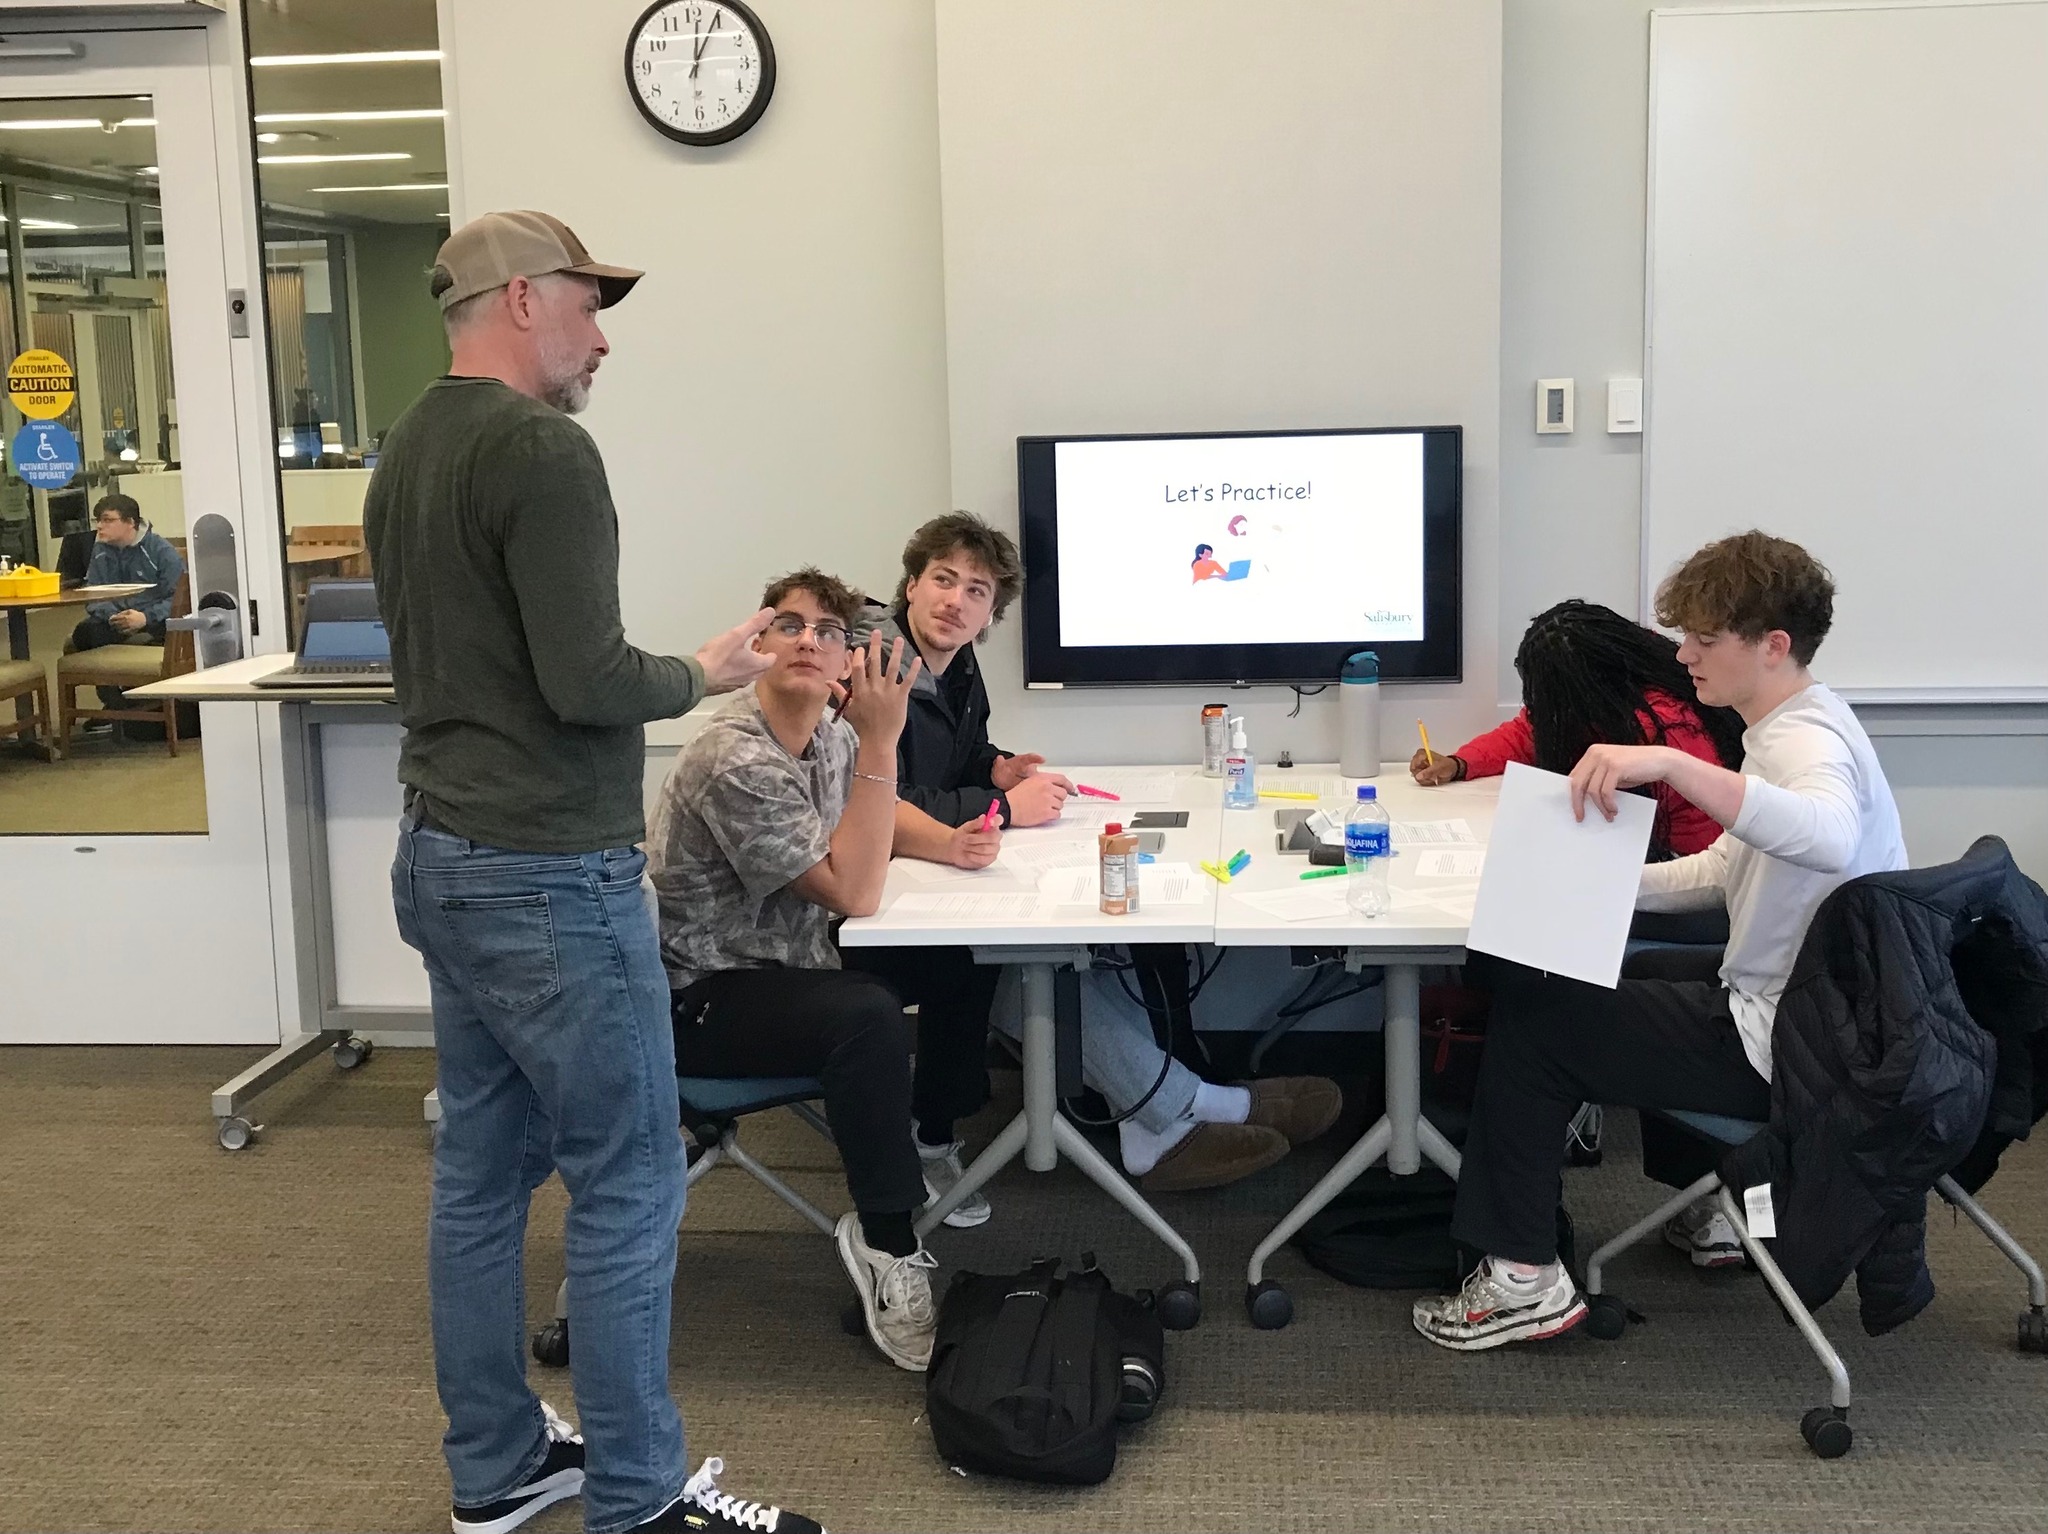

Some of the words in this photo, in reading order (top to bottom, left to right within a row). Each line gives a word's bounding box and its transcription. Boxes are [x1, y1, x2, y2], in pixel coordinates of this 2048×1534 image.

[685, 7, 702, 23] 12
[662, 16, 678, 32] 11
[650, 36, 666, 52] 10
[733, 34, 742, 48] 2
[642, 60, 652, 76] 9
[739, 55, 750, 71] 3
[651, 83, 662, 97] 8
[735, 78, 743, 94] 4
[672, 100, 681, 116] 7
[717, 98, 727, 113] 5
[695, 106, 705, 121] 6
[12, 365, 67, 374] AUTOMATIC
[10, 377, 70, 391] CAUTION
[29, 396, 56, 405] DOOR
[20, 462, 48, 471] ACTIVATE
[49, 462, 74, 470] SWITCH
[29, 471, 38, 480] TO
[38, 471, 66, 480] OPERATE
[1165, 484, 1214, 503] Let's
[1221, 480, 1311, 501] Practice!
